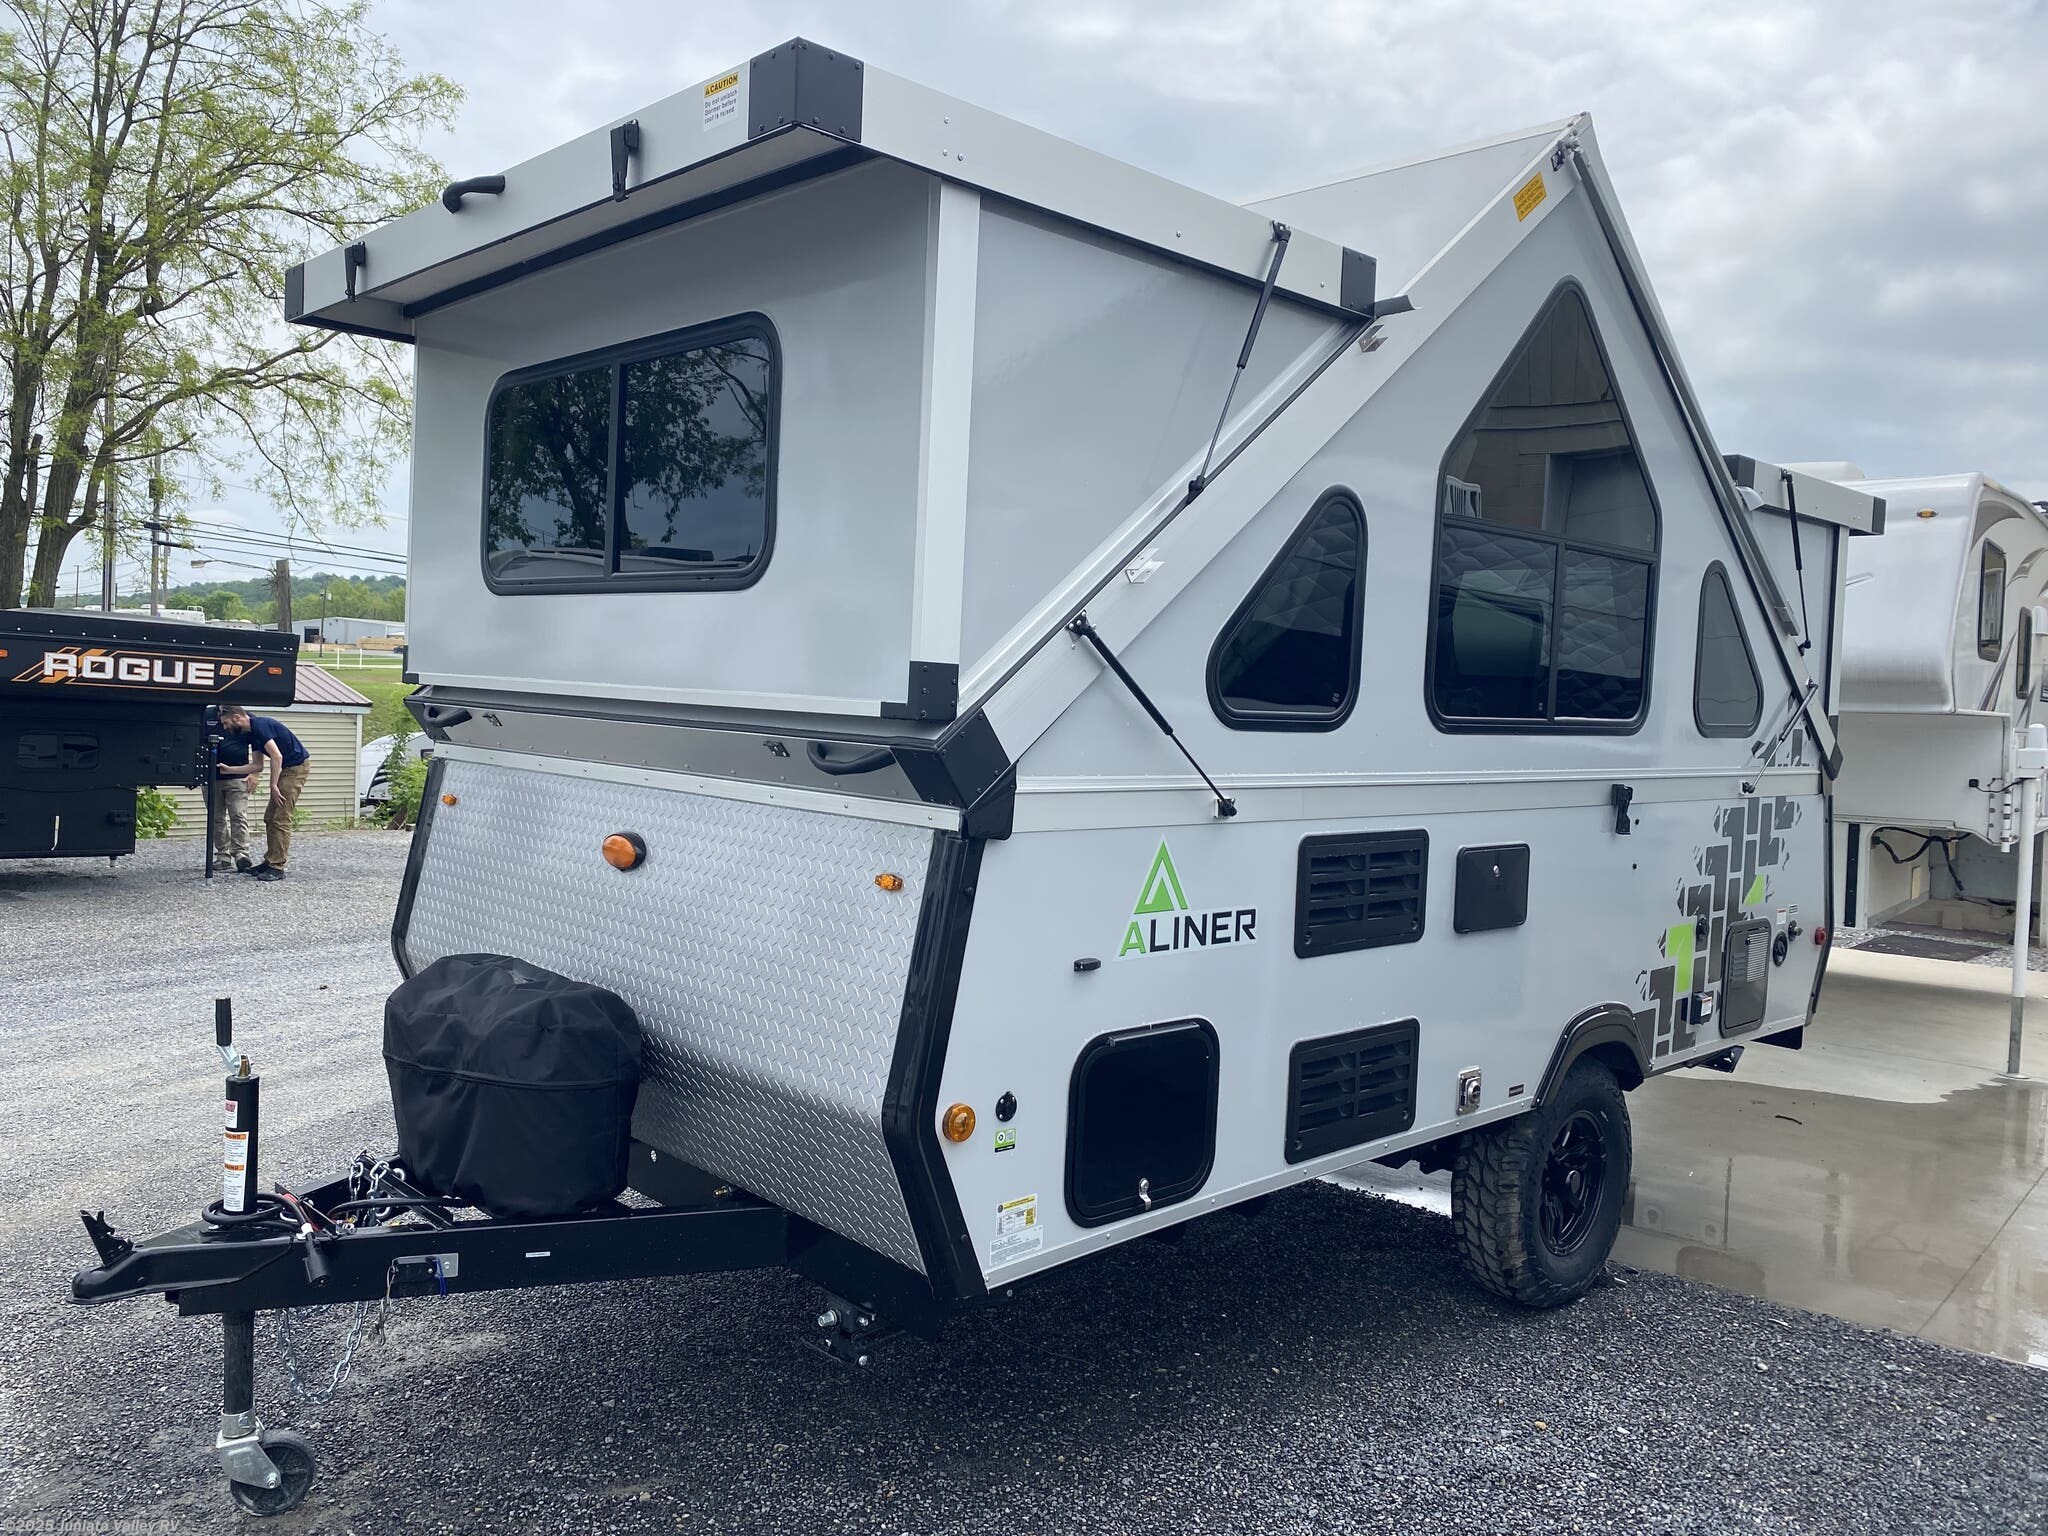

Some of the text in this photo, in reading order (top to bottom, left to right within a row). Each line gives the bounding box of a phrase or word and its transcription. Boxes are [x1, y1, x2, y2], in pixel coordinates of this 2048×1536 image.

[710, 75, 738, 93] CAUTION
[712, 97, 720, 106] not
[722, 98, 737, 109] before
[705, 114, 714, 124] roof
[44, 651, 215, 686] ROGUE
[1119, 908, 1257, 958] ALINER
